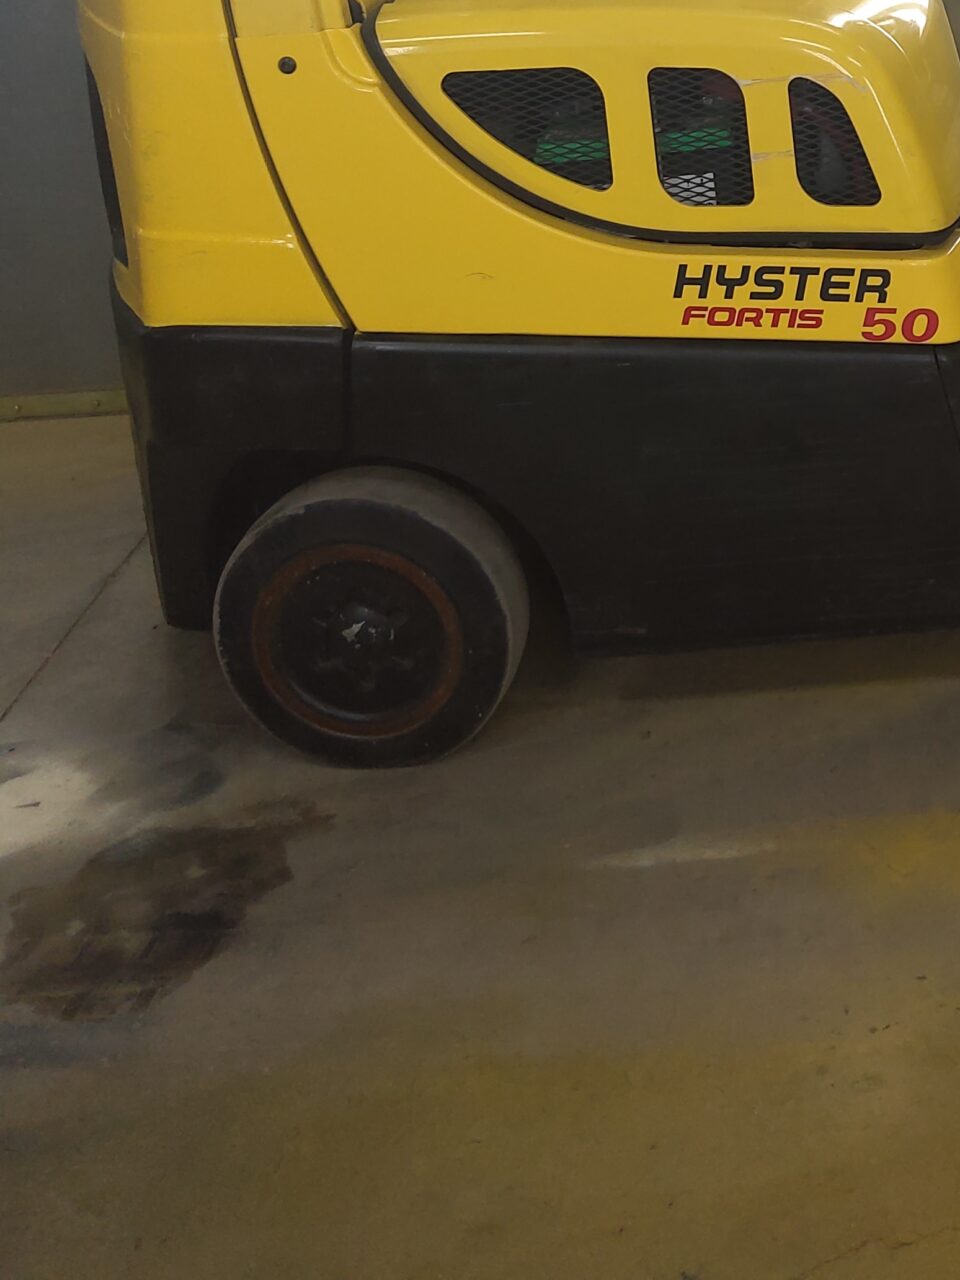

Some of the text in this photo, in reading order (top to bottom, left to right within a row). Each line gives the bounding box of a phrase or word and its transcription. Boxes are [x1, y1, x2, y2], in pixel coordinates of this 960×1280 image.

[673, 264, 892, 304] HYSTER
[681, 306, 940, 342] FORTIS 50
